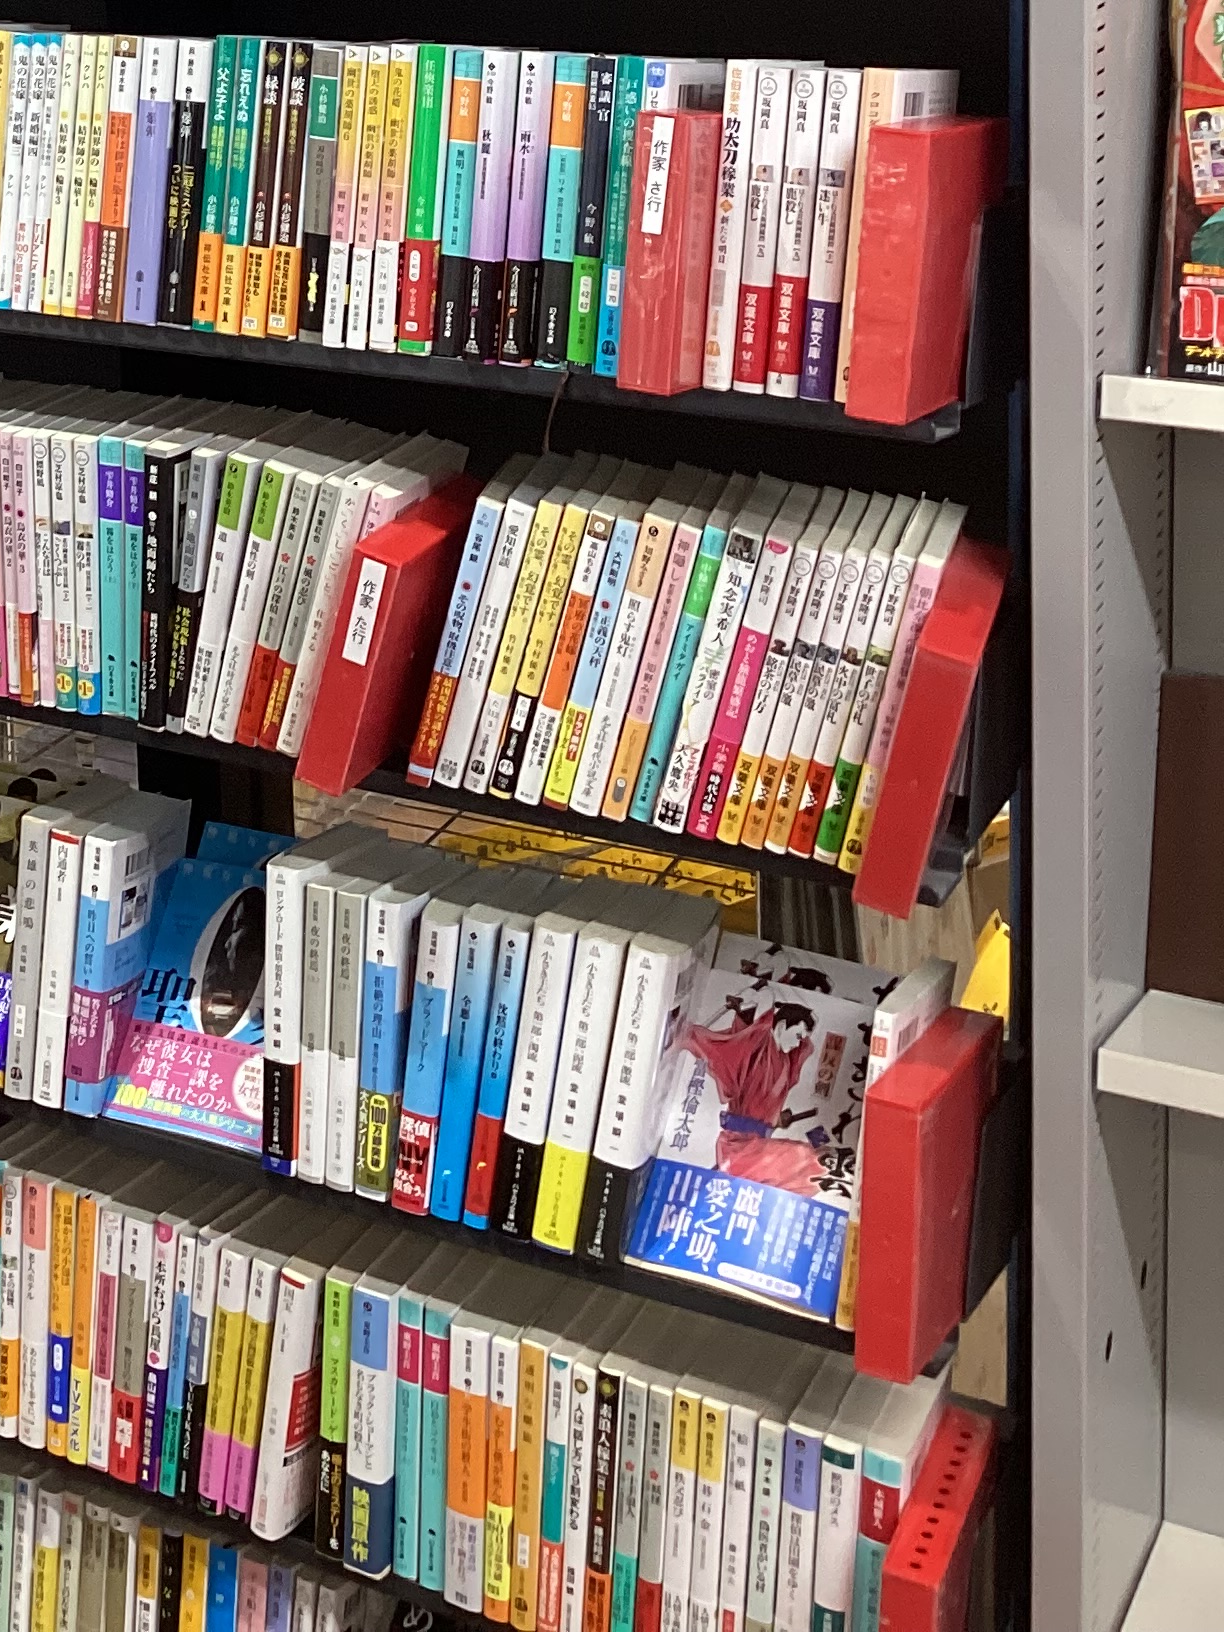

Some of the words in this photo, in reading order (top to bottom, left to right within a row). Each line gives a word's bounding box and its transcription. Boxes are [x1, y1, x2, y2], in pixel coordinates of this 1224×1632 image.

[15, 55, 28, 100] 鬼の花嫁
[32, 55, 44, 100] 鬼の花嫁
[46, 55, 58, 100] 鬼の花嫁
[214, 67, 230, 121] 父よ子よ
[236, 68, 253, 123] 忘れえぬ
[485, 79, 494, 104] 今野敏
[524, 79, 533, 104] 今野敏
[596, 72, 613, 122] 審議官
[729, 67, 742, 116] 佐伯泰英
[458, 85, 471, 117] 今野敏
[561, 91, 574, 123] 今野敏
[760, 97, 772, 130] 坂岡真
[795, 99, 808, 133] 坂岡真
[829, 101, 841, 134] 坂岡真
[519, 130, 531, 155] 雨水
[651, 140, 670, 172] 作家
[720, 118, 741, 198] 助太刀稼業
[415, 196, 425, 235] 今野敏
[645, 179, 662, 213] さ行
[583, 203, 598, 245] 今野敏
[742, 292, 758, 344] 双葉文庫
[777, 282, 793, 335] 双葉文庫
[807, 308, 826, 360] 双葉文庫
[358, 580, 378, 609] 作家
[758, 565, 776, 606] 千野隆司
[786, 577, 802, 617] 千野隆司
[810, 580, 826, 620] 千野隆司
[833, 584, 849, 624] 千野隆司
[858, 584, 874, 625] 千野隆司
[884, 585, 900, 626] 千野隆司
[711, 572, 742, 645] 知念実希人
[350, 614, 370, 646] た行
[130, 1035, 213, 1068] なぜ彼女は
[137, 1057, 223, 1091] 捜査一課を
[149, 1080, 232, 1113] 離れたのか
